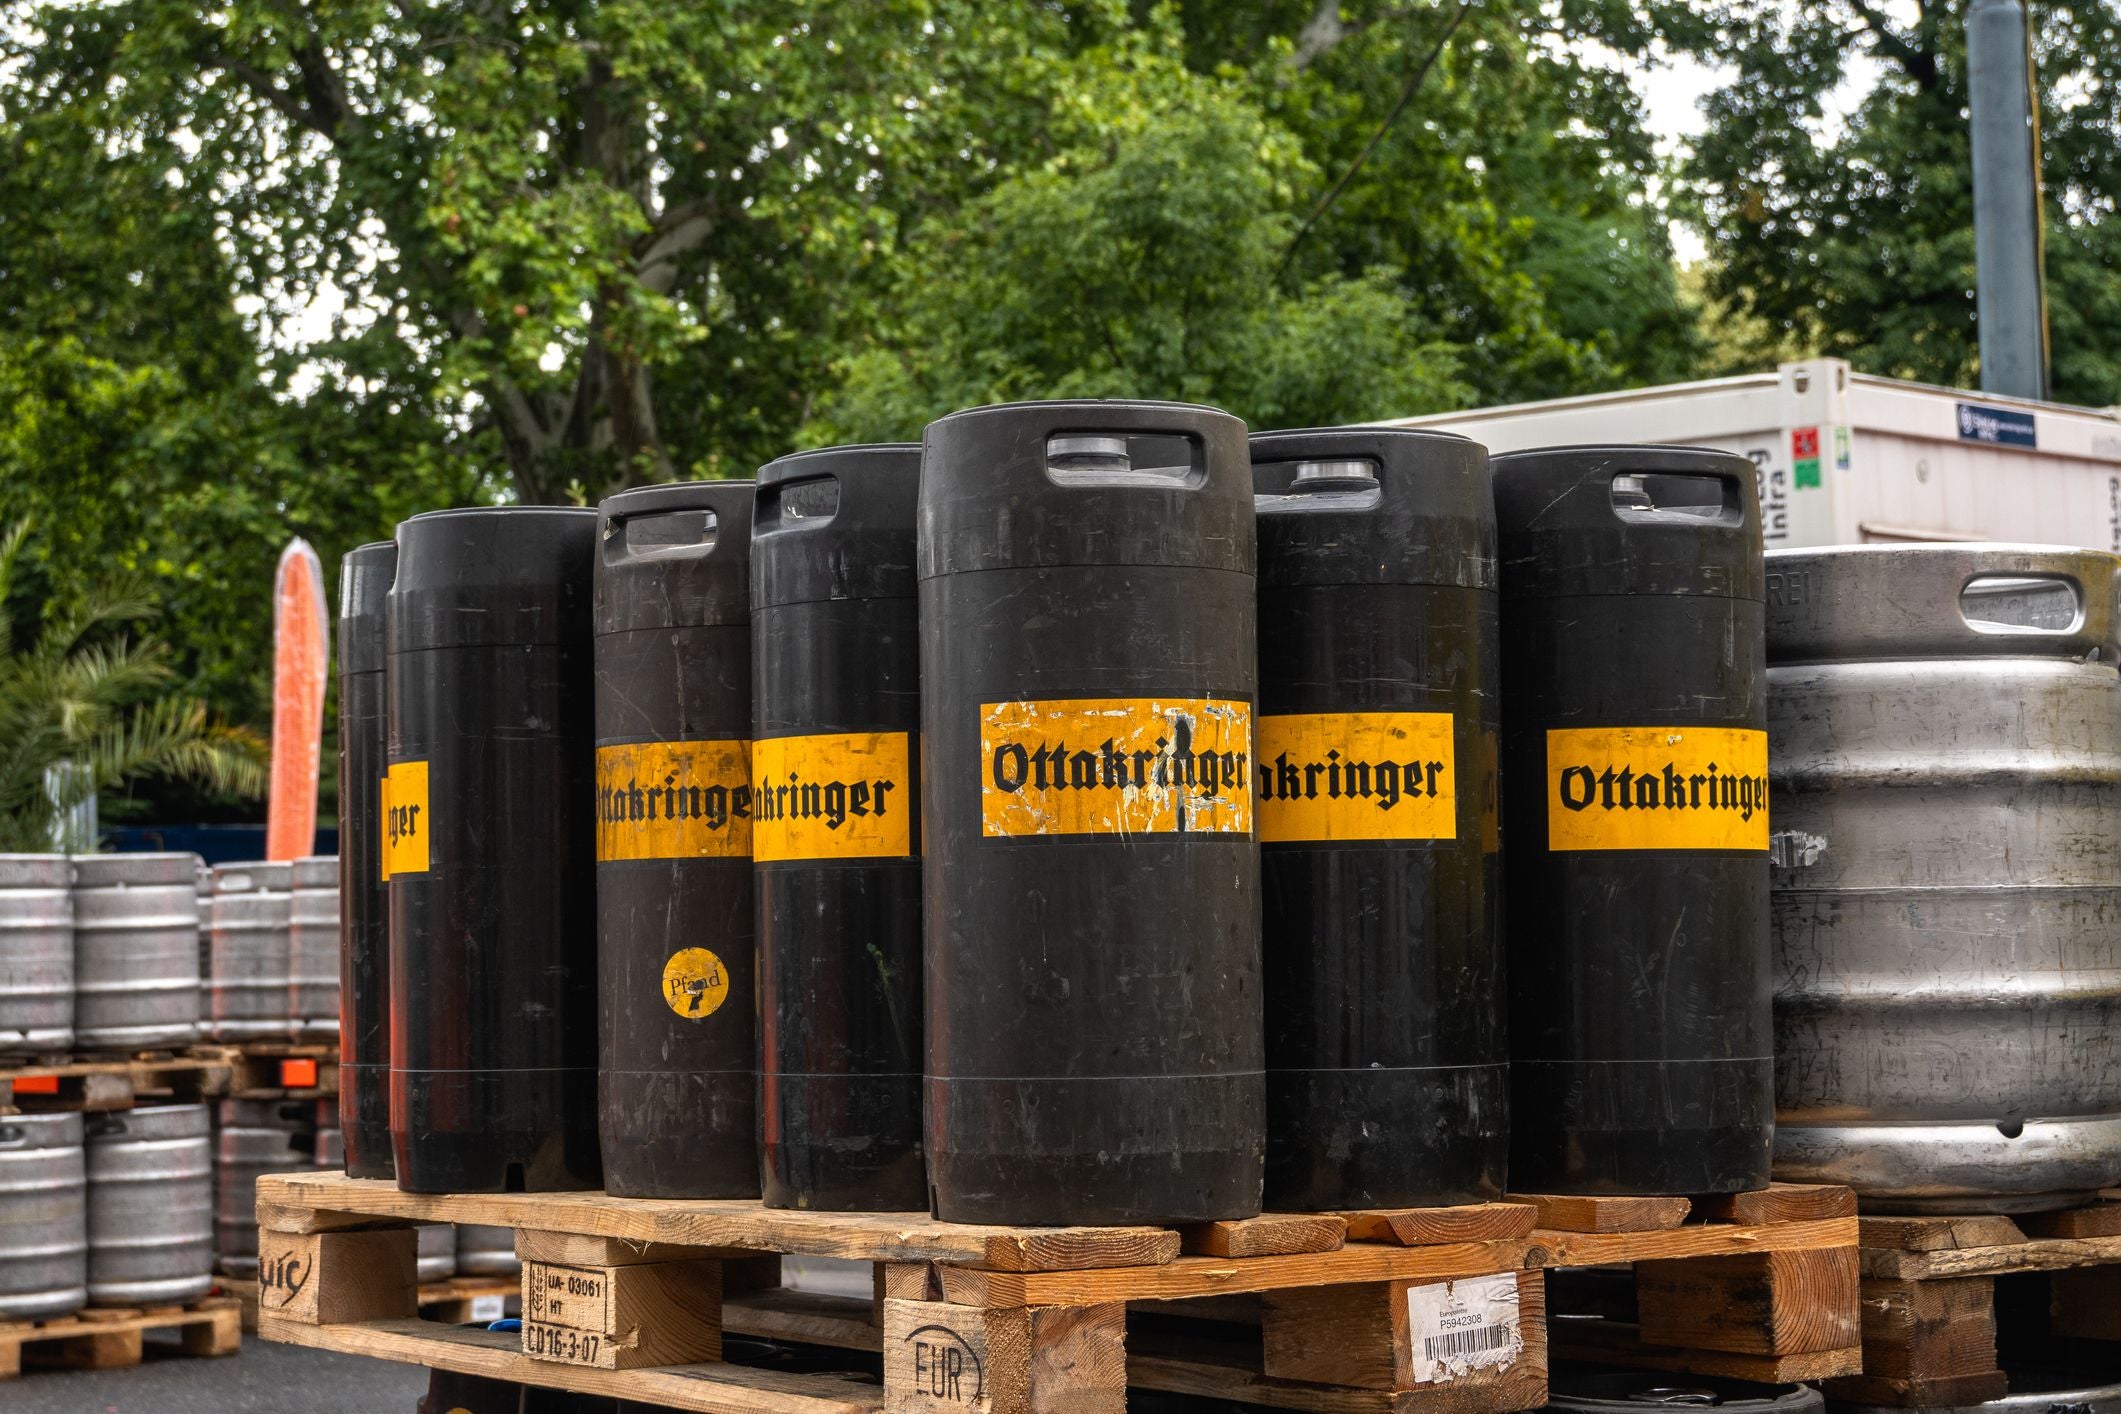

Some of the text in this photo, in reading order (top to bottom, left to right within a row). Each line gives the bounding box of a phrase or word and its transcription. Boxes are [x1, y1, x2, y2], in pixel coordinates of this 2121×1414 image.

[993, 735, 1247, 801] Ottakringer
[1560, 761, 1767, 823] Ottakringer
[550, 1299, 563, 1315] HT
[1440, 1313, 1482, 1330] P5942308
[915, 1341, 961, 1402] EUR
